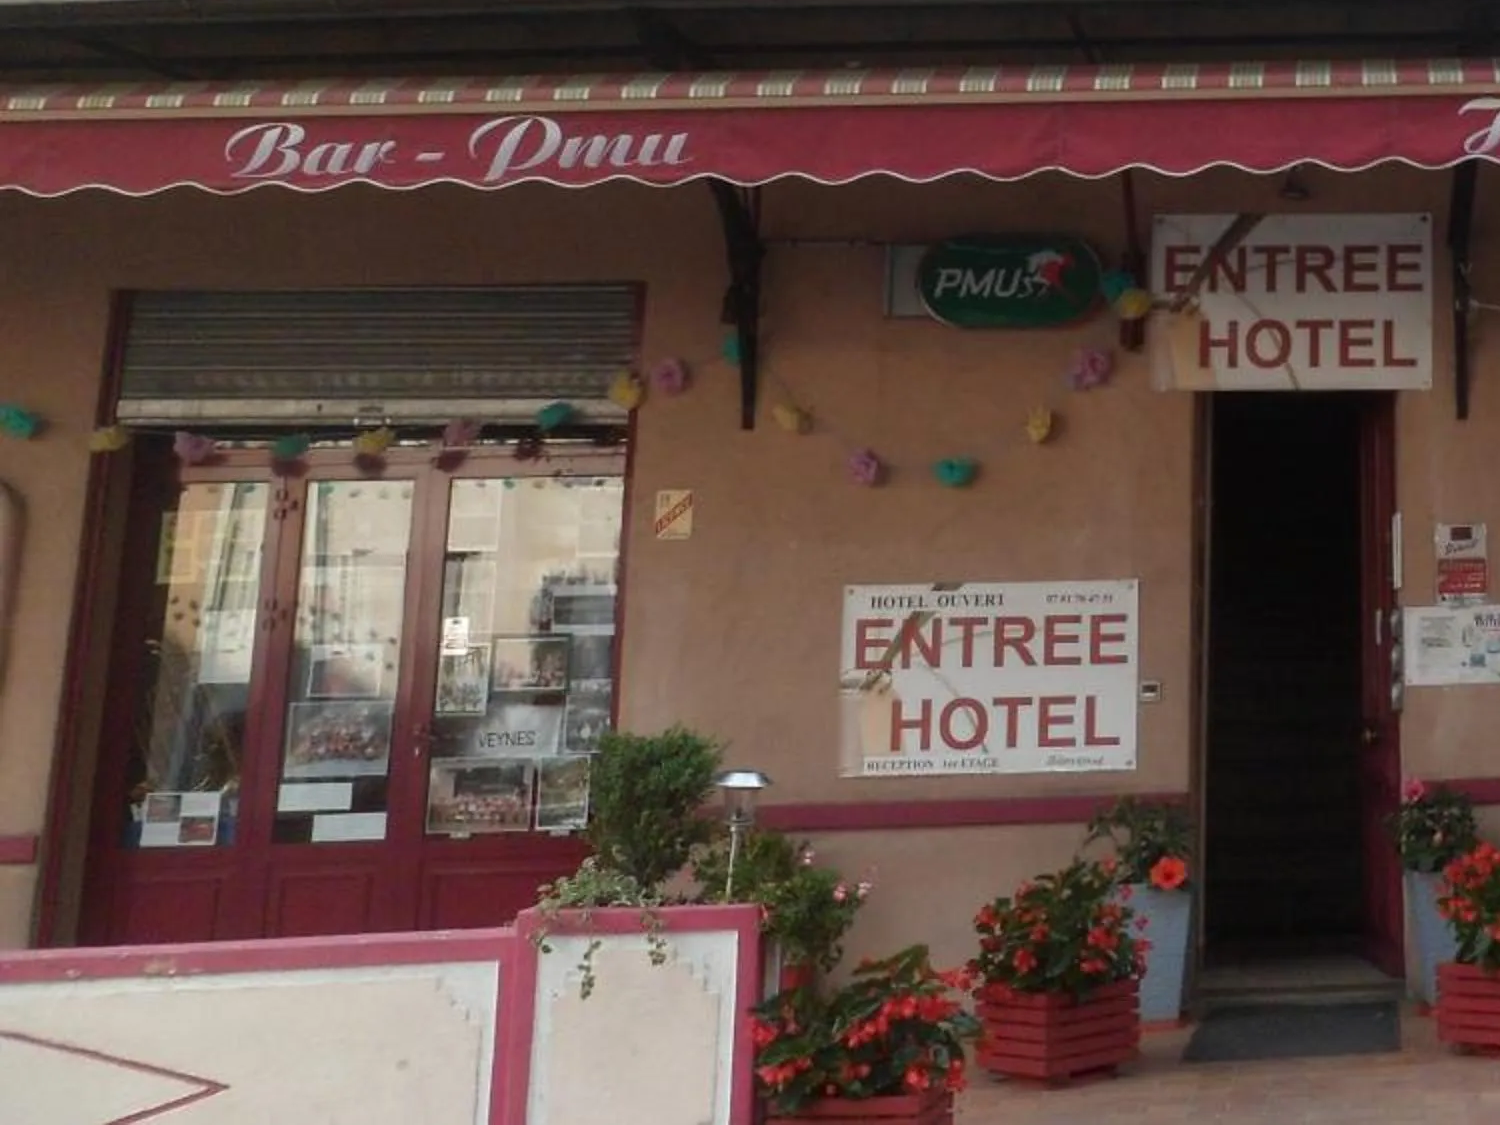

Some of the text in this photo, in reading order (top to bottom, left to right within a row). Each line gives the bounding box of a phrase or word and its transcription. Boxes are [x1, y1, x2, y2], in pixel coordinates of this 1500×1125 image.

[225, 121, 398, 178] Bar
[933, 266, 1024, 299] PMU
[1164, 243, 1424, 294] ENTREE
[1200, 319, 1418, 369] HOTEL
[871, 594, 929, 609] HOTEL
[937, 593, 1004, 608] OUVERT
[855, 613, 1129, 670] ENTREE
[890, 695, 1121, 753] HOTEL
